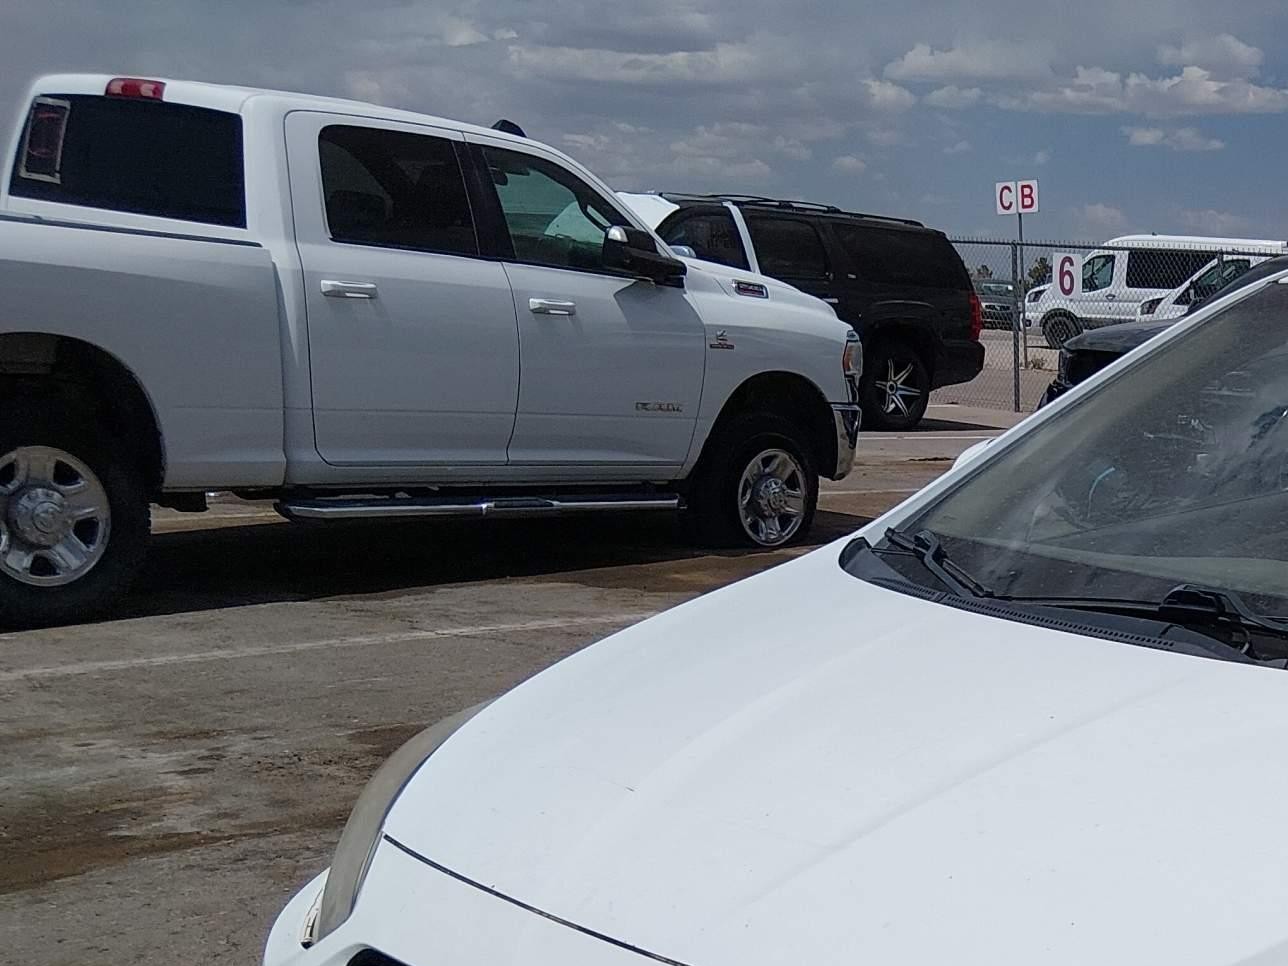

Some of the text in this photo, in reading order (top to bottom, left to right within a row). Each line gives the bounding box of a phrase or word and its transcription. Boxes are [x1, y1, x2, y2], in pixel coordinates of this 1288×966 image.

[999, 183, 1035, 211] C B
[1059, 255, 1075, 296] 6
